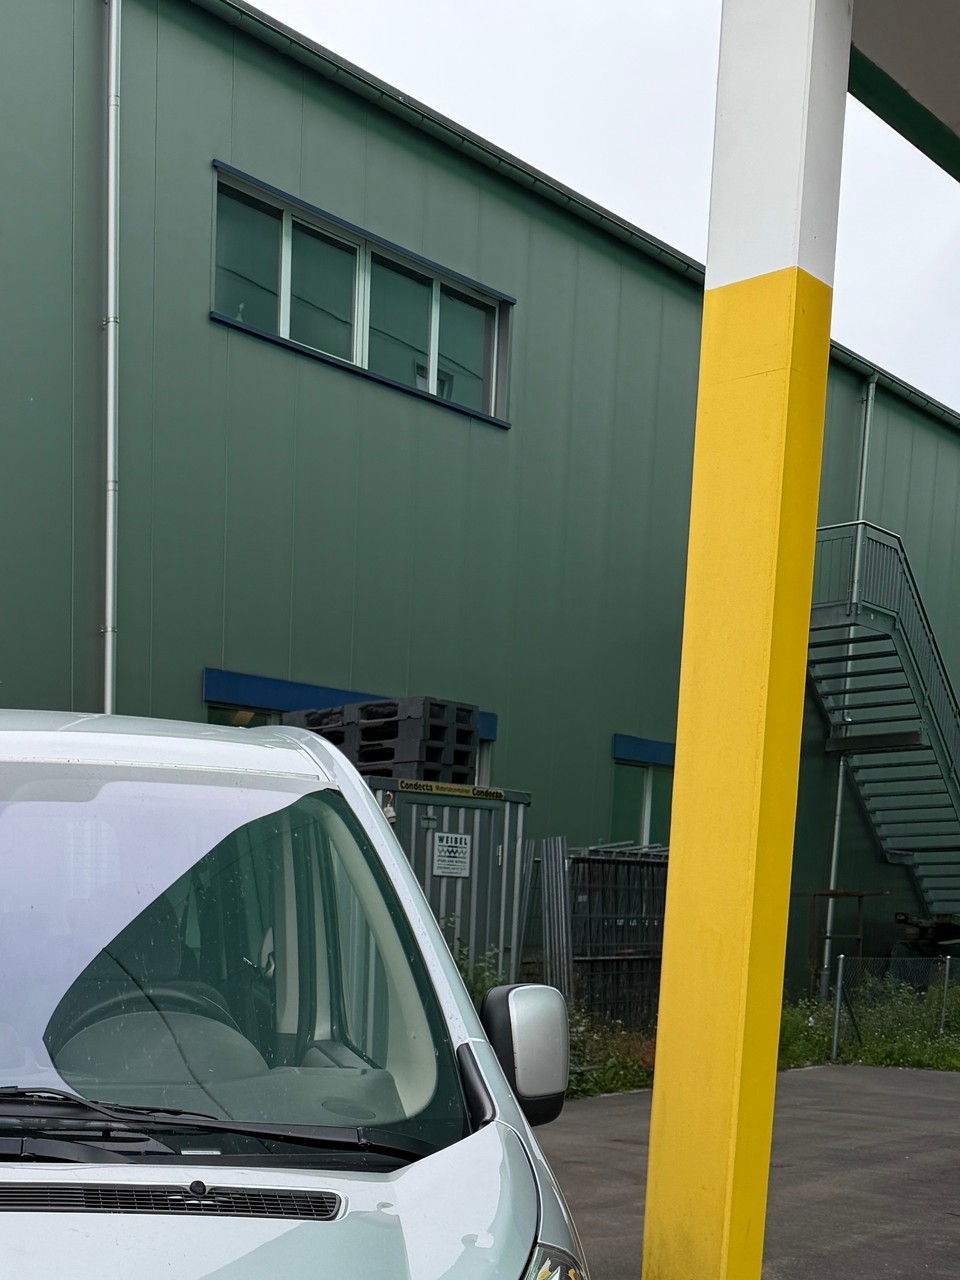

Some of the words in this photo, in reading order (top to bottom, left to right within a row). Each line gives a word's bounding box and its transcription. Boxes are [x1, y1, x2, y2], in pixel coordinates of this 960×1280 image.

[400, 780, 433, 791] Condecta
[472, 787, 503, 799] Condecta
[437, 835, 468, 846] WEIBEL
